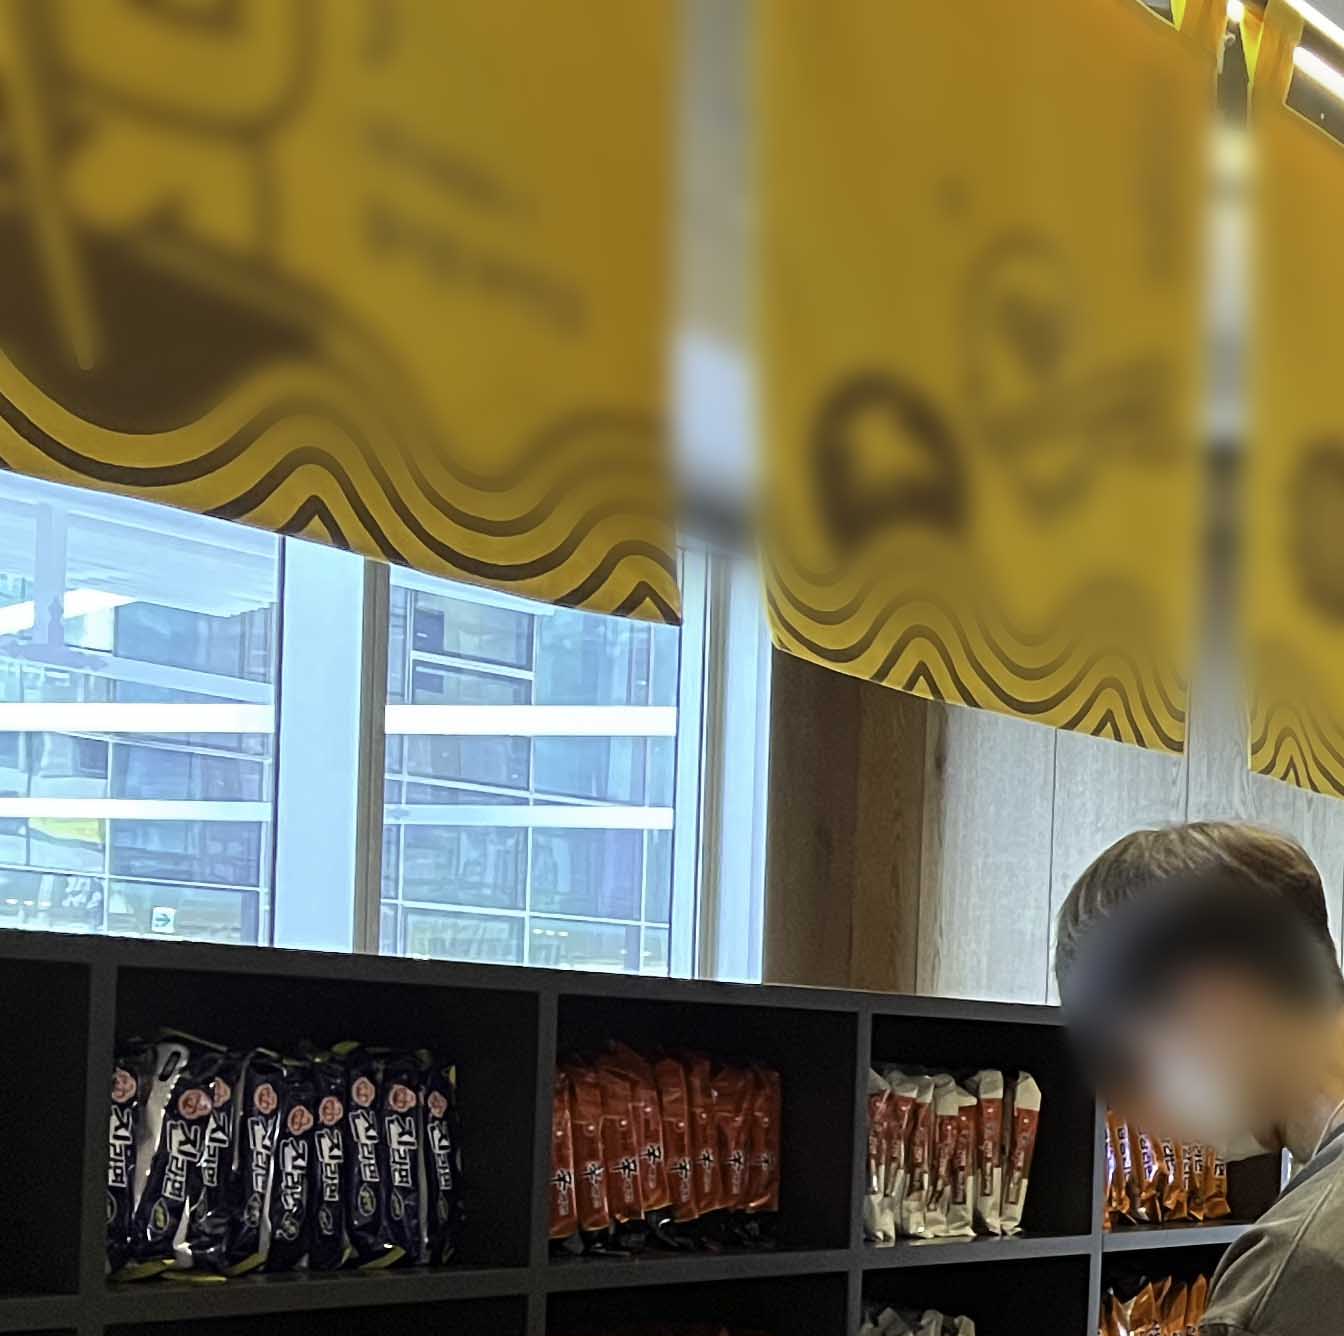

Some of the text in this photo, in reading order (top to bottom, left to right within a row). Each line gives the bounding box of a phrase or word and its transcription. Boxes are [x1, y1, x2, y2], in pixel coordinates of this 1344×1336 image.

[162, 1120, 200, 1201] 진라면
[315, 1128, 344, 1201] 진라면
[350, 1109, 380, 1182] 진라면
[385, 1114, 417, 1187] 진라면
